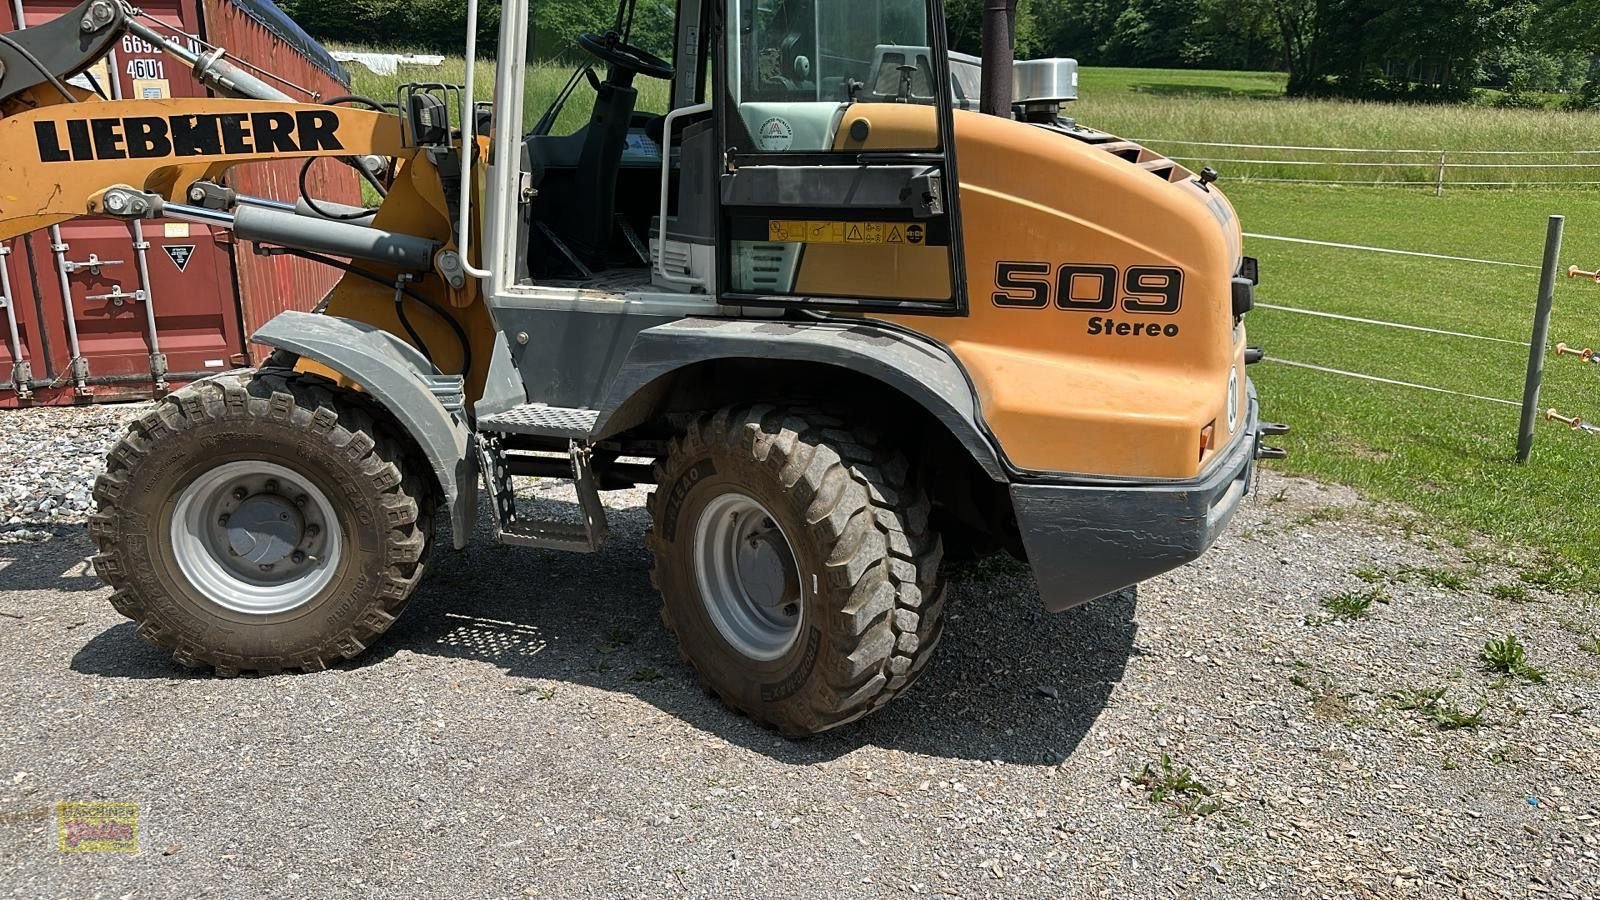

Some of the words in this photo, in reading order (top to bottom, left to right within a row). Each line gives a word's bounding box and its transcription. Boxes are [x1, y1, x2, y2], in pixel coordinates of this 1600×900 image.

[126, 59, 164, 79] 46U1
[34, 110, 344, 162] LIEBHERR
[991, 260, 1185, 315] 509
[1087, 317, 1179, 337] Stereo
